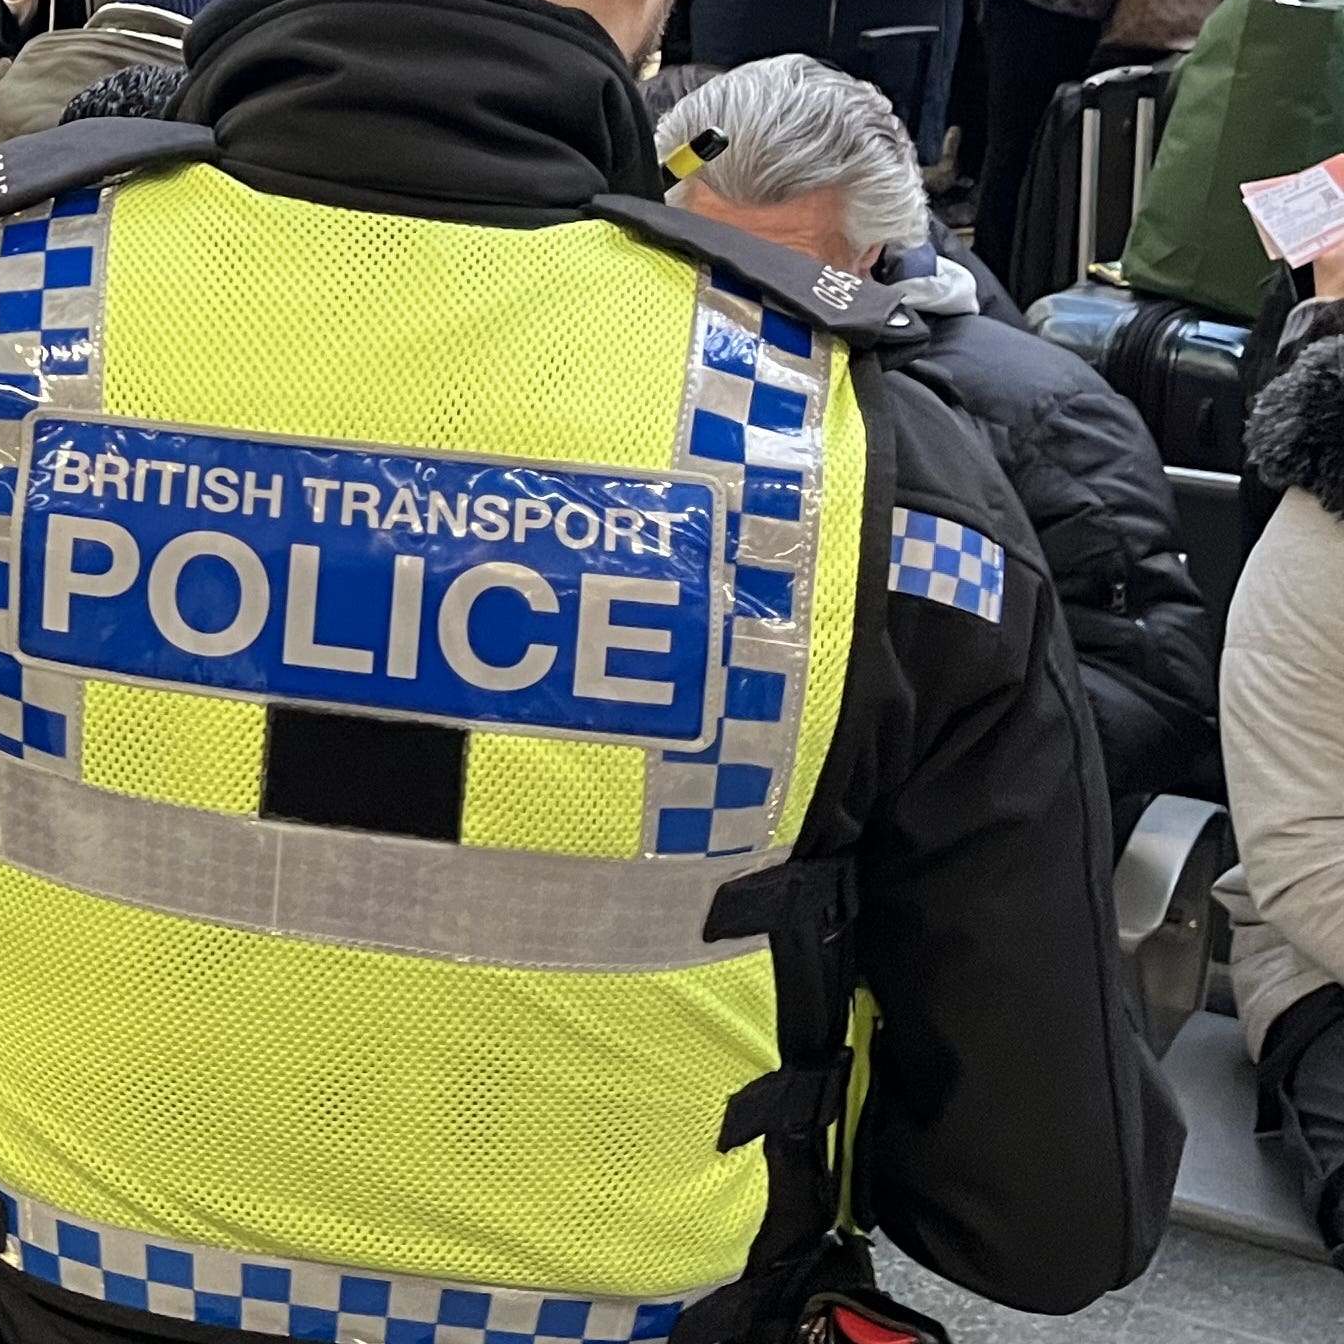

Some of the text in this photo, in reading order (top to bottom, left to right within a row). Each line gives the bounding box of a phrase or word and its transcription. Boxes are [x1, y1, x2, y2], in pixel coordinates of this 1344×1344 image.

[812, 265, 863, 310] 0545
[52, 450, 689, 557] BRITISH TRANSPORT
[42, 513, 681, 706] POLICE
